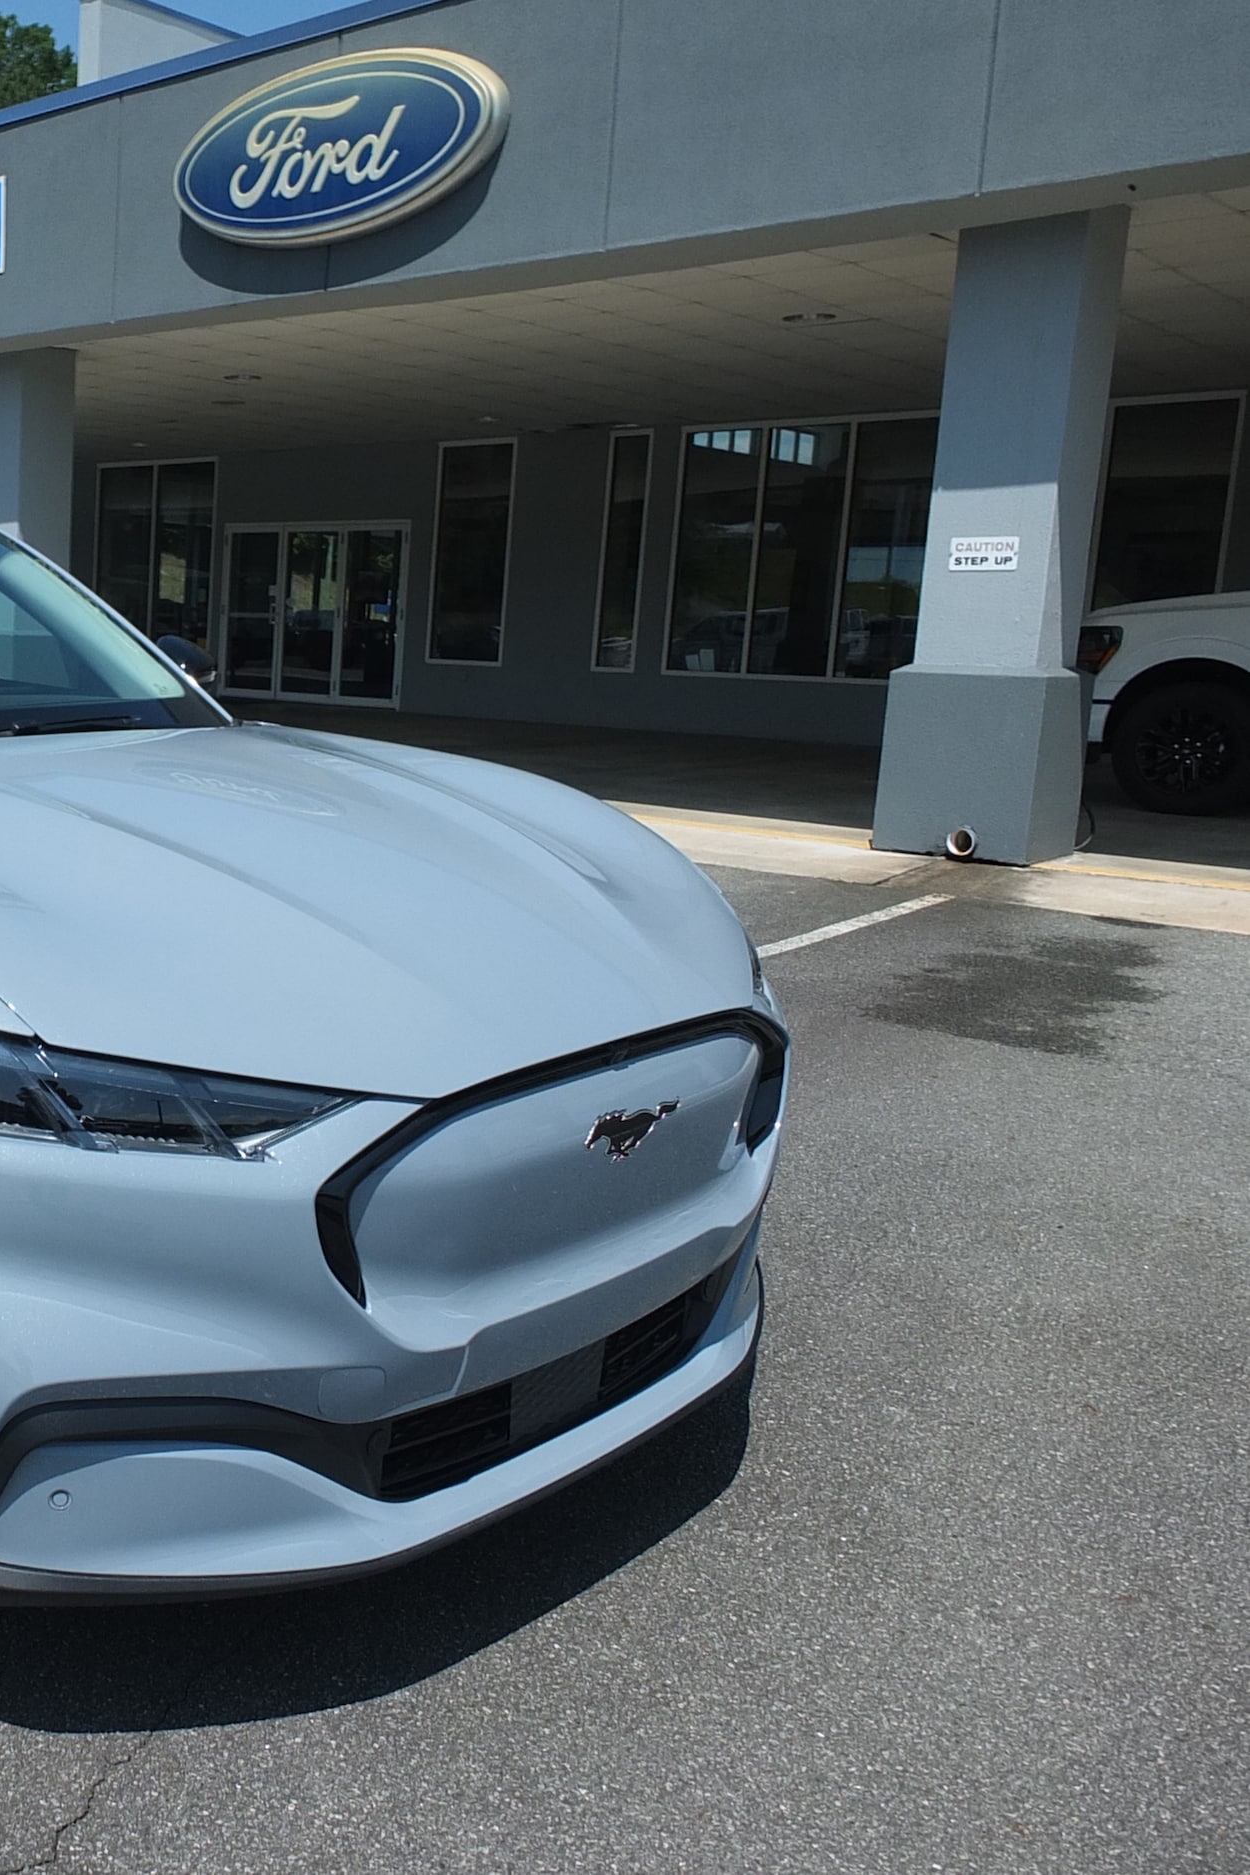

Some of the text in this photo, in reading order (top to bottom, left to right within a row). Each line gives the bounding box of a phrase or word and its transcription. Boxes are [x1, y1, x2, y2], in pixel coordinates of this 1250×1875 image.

[229, 94, 406, 210] Ford
[954, 541, 1015, 553] CAUTION
[953, 556, 1013, 566] STEP UP
